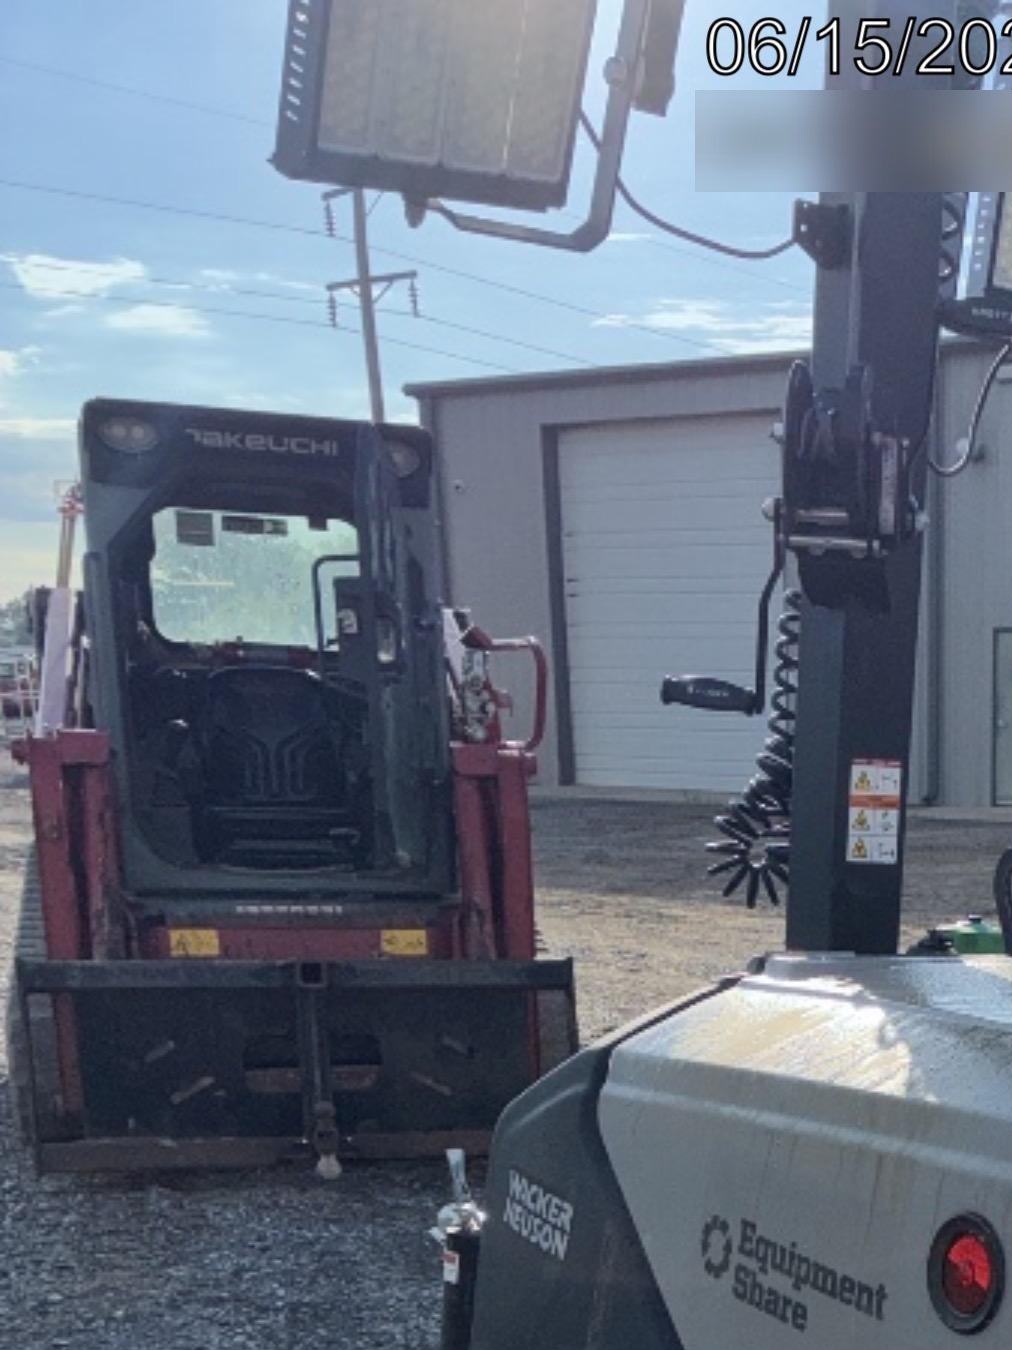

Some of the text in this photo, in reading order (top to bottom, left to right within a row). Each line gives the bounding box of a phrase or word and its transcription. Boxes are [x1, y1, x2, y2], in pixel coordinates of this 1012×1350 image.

[502, 1196, 571, 1262] NEUSON
[507, 1169, 575, 1230] WACKER
[731, 1262, 808, 1333] Share
[737, 1217, 889, 1321] Equipment
